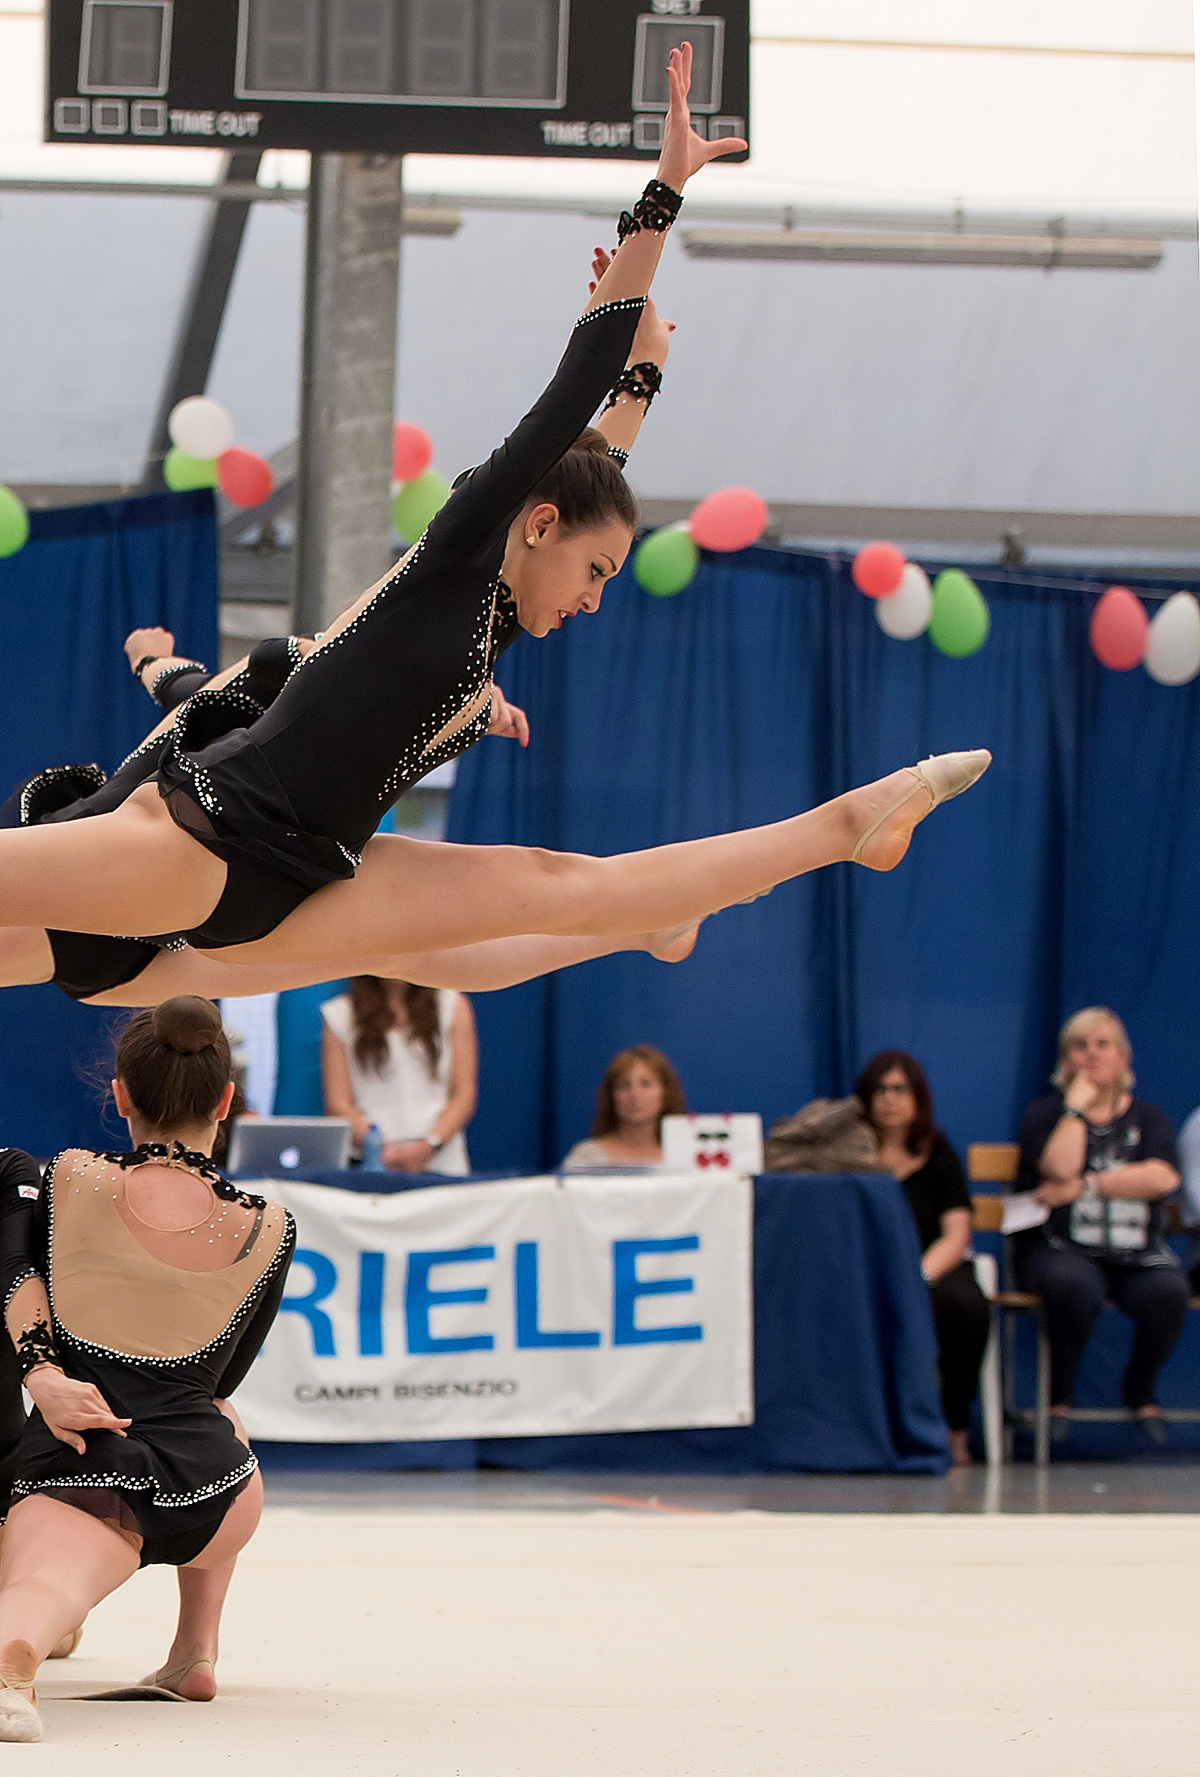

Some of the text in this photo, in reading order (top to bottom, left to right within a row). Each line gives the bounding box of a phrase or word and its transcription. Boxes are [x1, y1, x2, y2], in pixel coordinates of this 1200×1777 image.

[168, 109, 262, 137] TIME OUT
[540, 120, 632, 148] TIME OUT
[258, 1236, 703, 1356] RIELE
[295, 1379, 517, 1402] CAMPI BISENZIO
